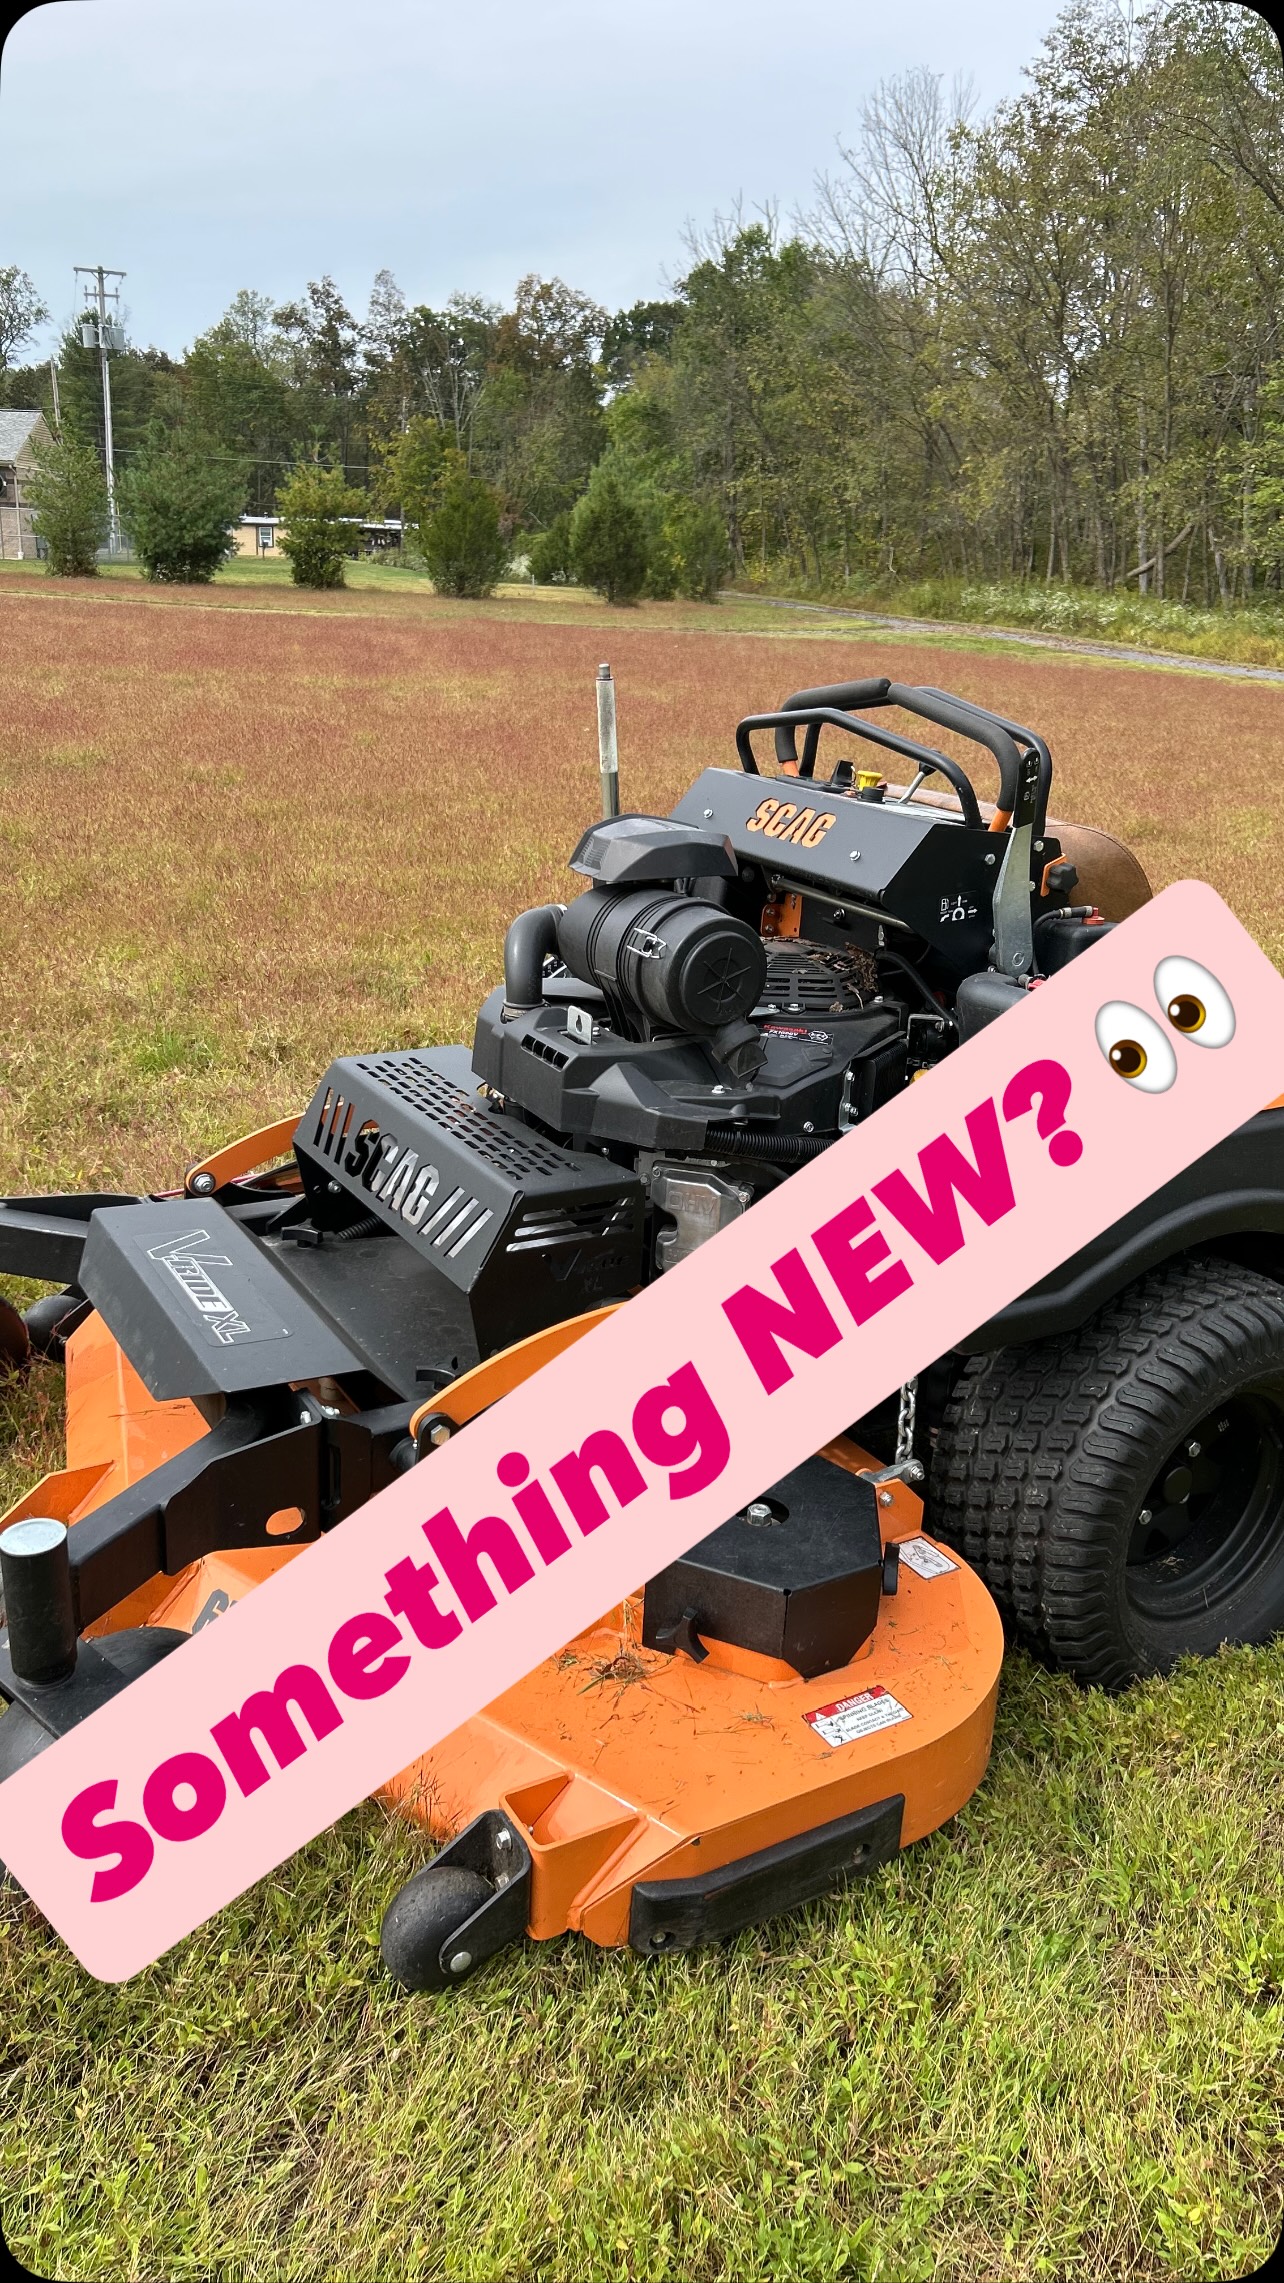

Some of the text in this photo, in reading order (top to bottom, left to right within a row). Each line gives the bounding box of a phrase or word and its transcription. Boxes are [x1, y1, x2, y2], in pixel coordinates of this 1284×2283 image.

[746, 798, 837, 848] SCAG
[344, 1119, 440, 1227] SCAG
[203, 1310, 251, 1344] XL
[835, 1692, 874, 1712] DANGER
